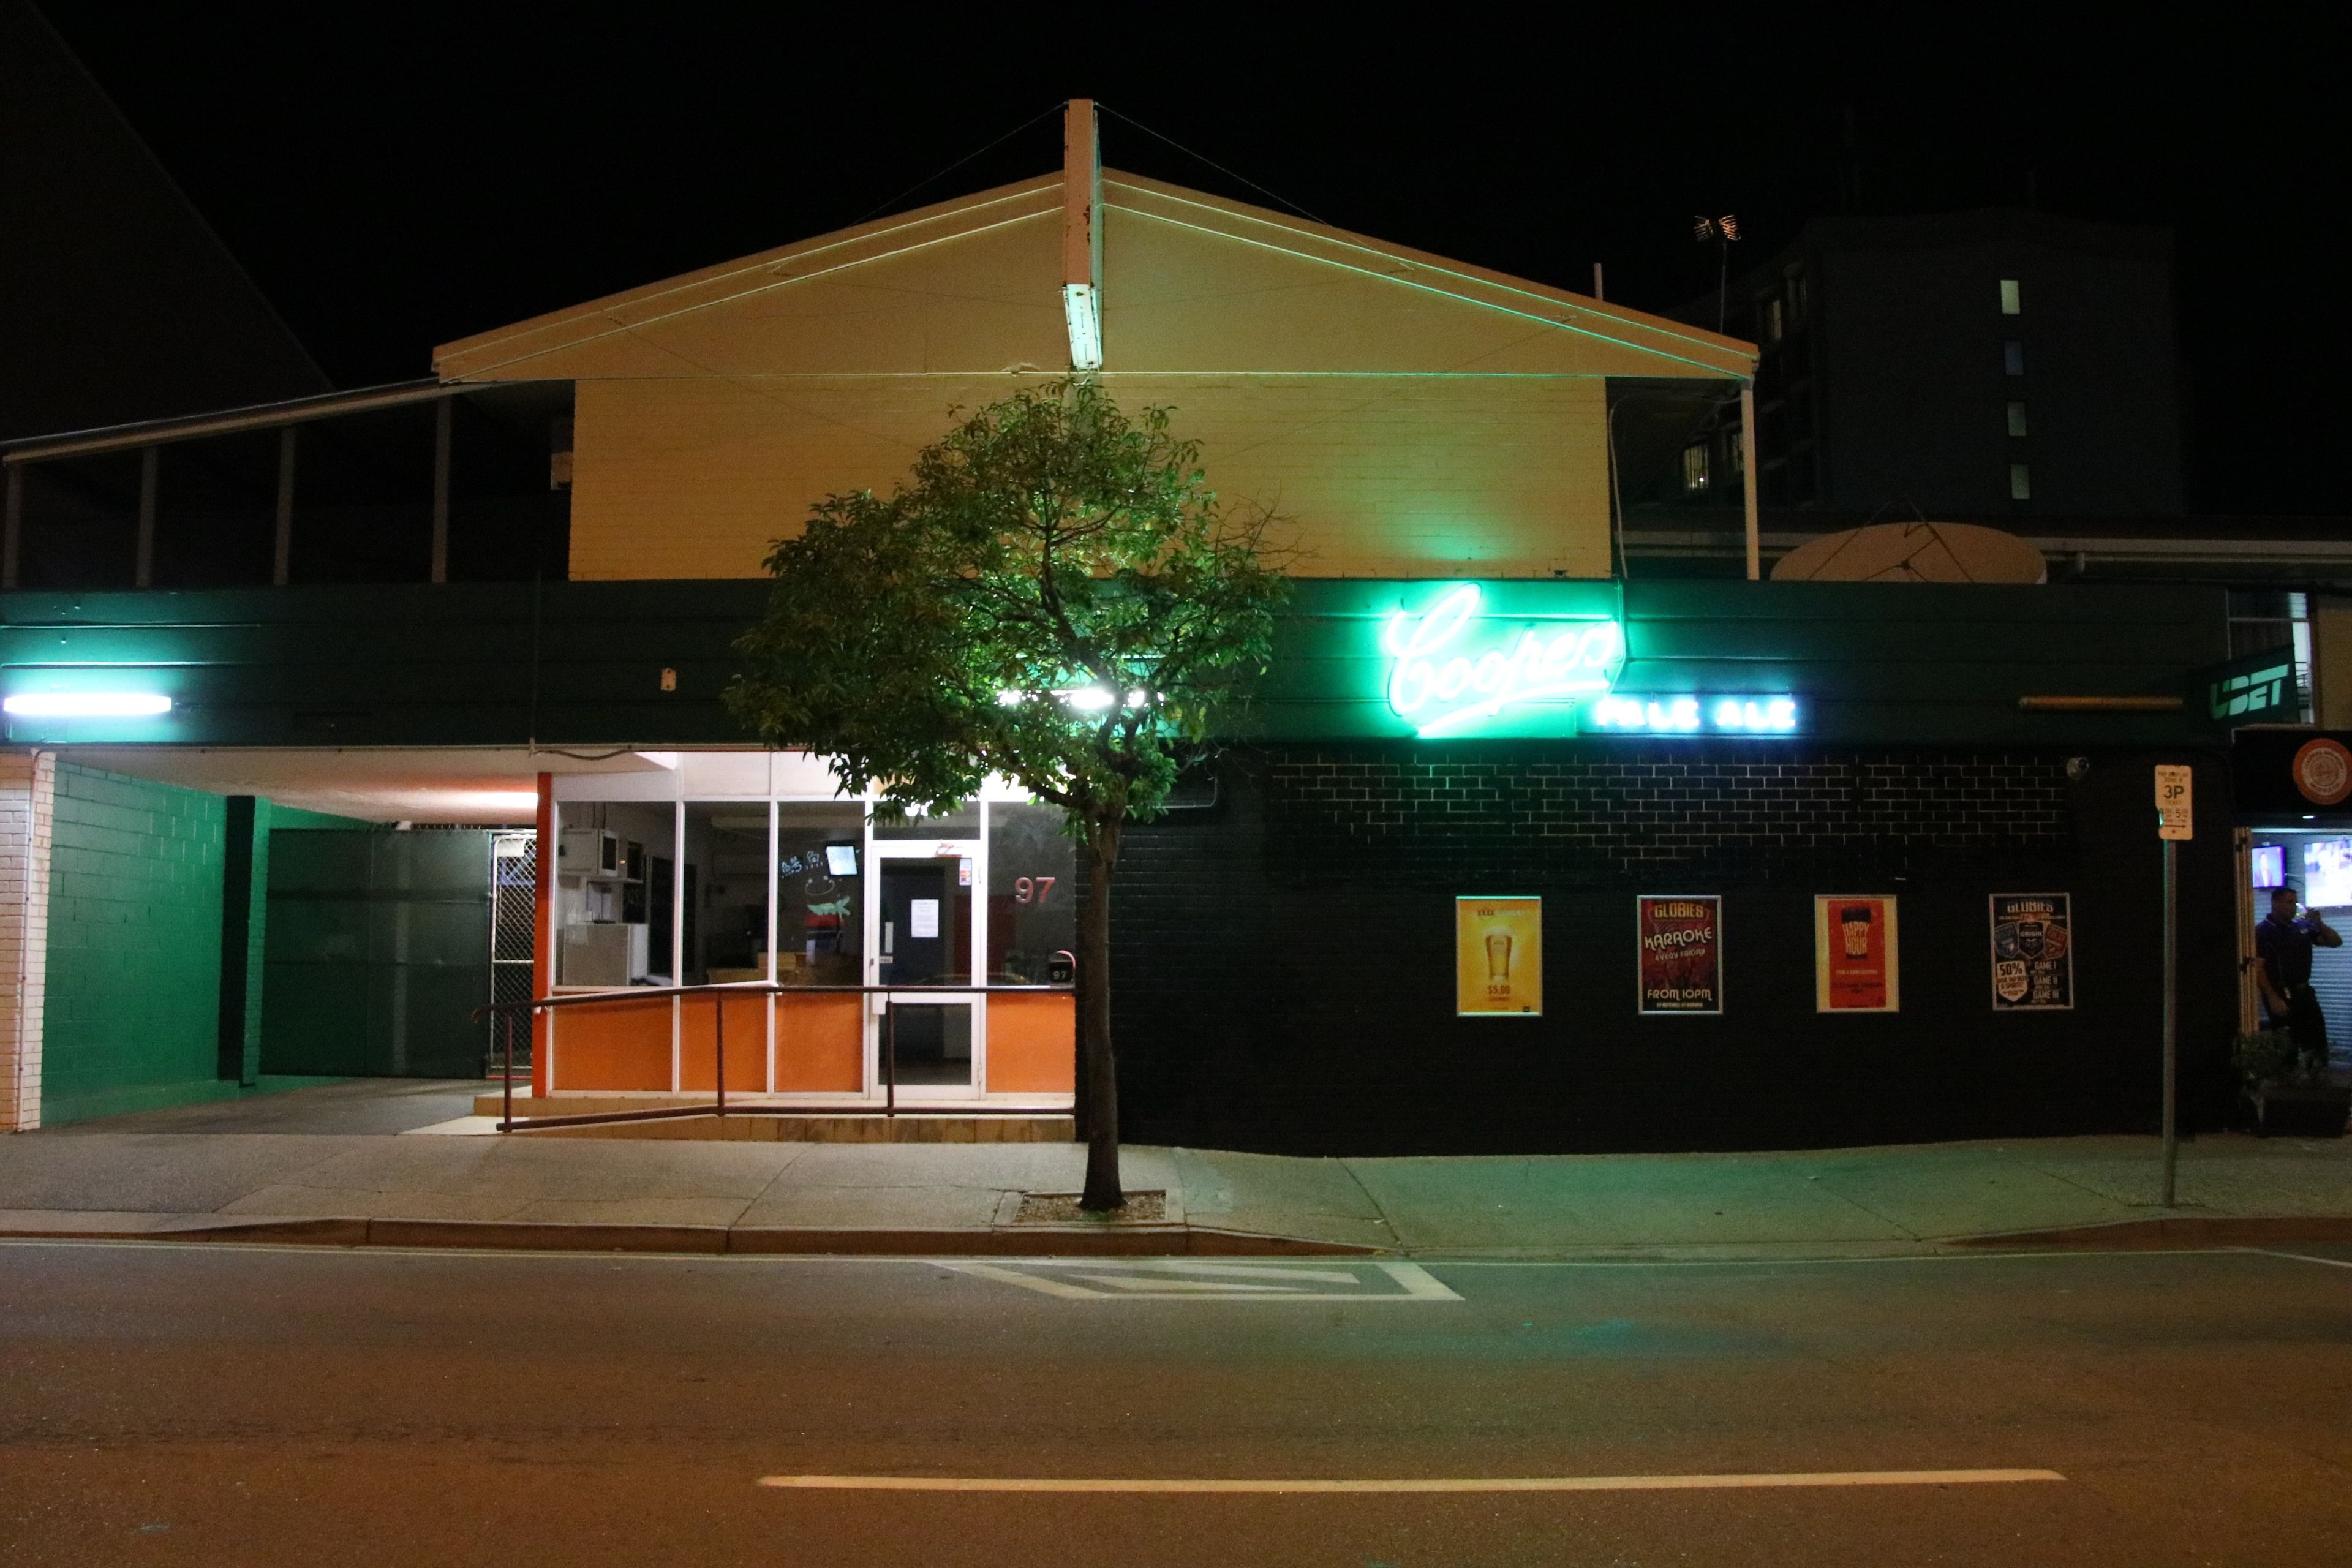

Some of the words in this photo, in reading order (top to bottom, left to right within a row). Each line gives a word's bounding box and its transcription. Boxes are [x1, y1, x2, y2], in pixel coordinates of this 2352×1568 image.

[1385, 582, 1618, 718] Coopers
[2209, 664, 2289, 720] UBET
[1597, 701, 1698, 726] PALE
[1717, 701, 1795, 726] ALE
[2164, 785, 2184, 799] 3P
[1014, 876, 1055, 903] 97
[1654, 902, 1704, 918] GLOBIES
[1842, 921, 1870, 937] HAPPY
[1644, 926, 1713, 951] KARAOKE
[1845, 937, 1868, 955] HOUR
[1656, 952, 1678, 961] EVERY
[1680, 948, 1706, 959] FRIDAY
[1054, 971, 1067, 979] 97
[1999, 963, 2023, 976] 50%
[2034, 976, 2052, 985] GAME
[1647, 989, 1680, 1001] FROM
[1682, 989, 1712, 1001] 10PM
[2033, 990, 2051, 999] GAME
